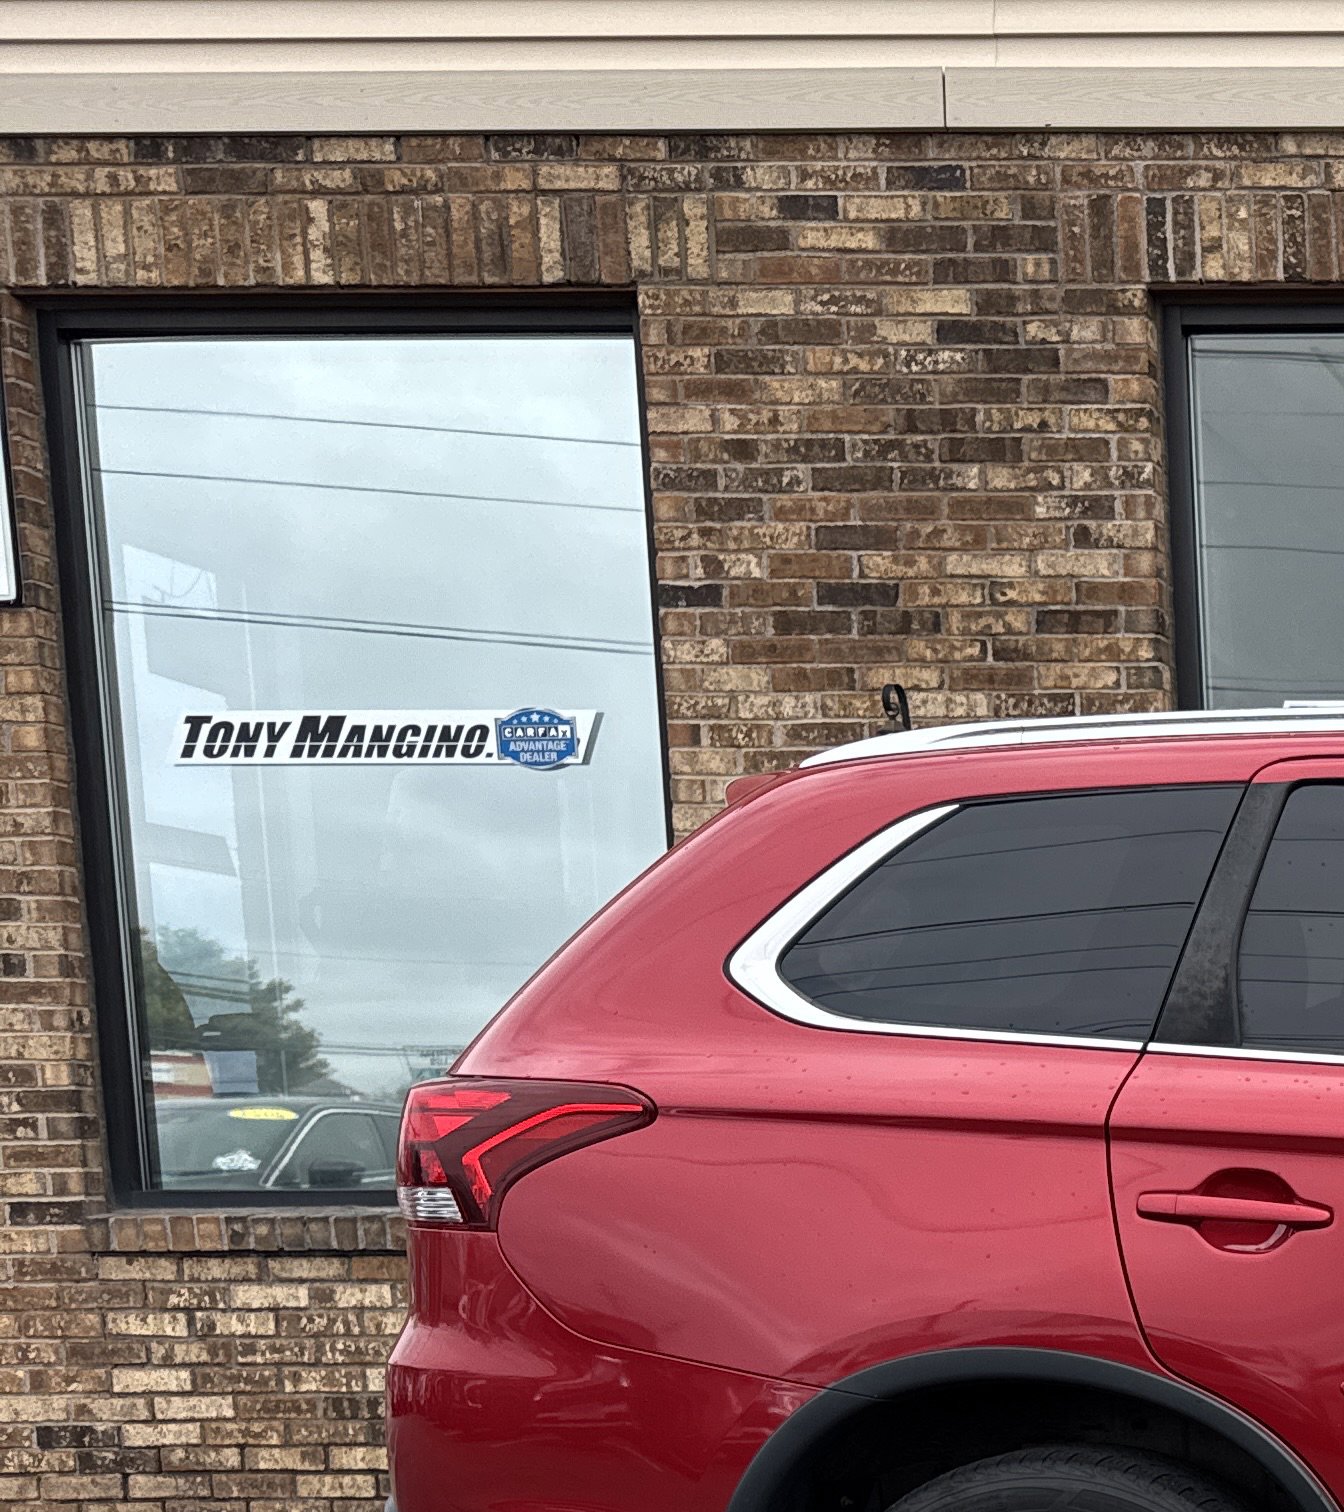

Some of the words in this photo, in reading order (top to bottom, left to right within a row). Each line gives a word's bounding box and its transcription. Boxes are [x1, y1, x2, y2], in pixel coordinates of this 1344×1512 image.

[180, 715, 291, 759] TONY
[503, 725, 571, 739] CARFAX
[508, 740, 568, 753] ADVANTAGE
[519, 752, 558, 763] DEALER
